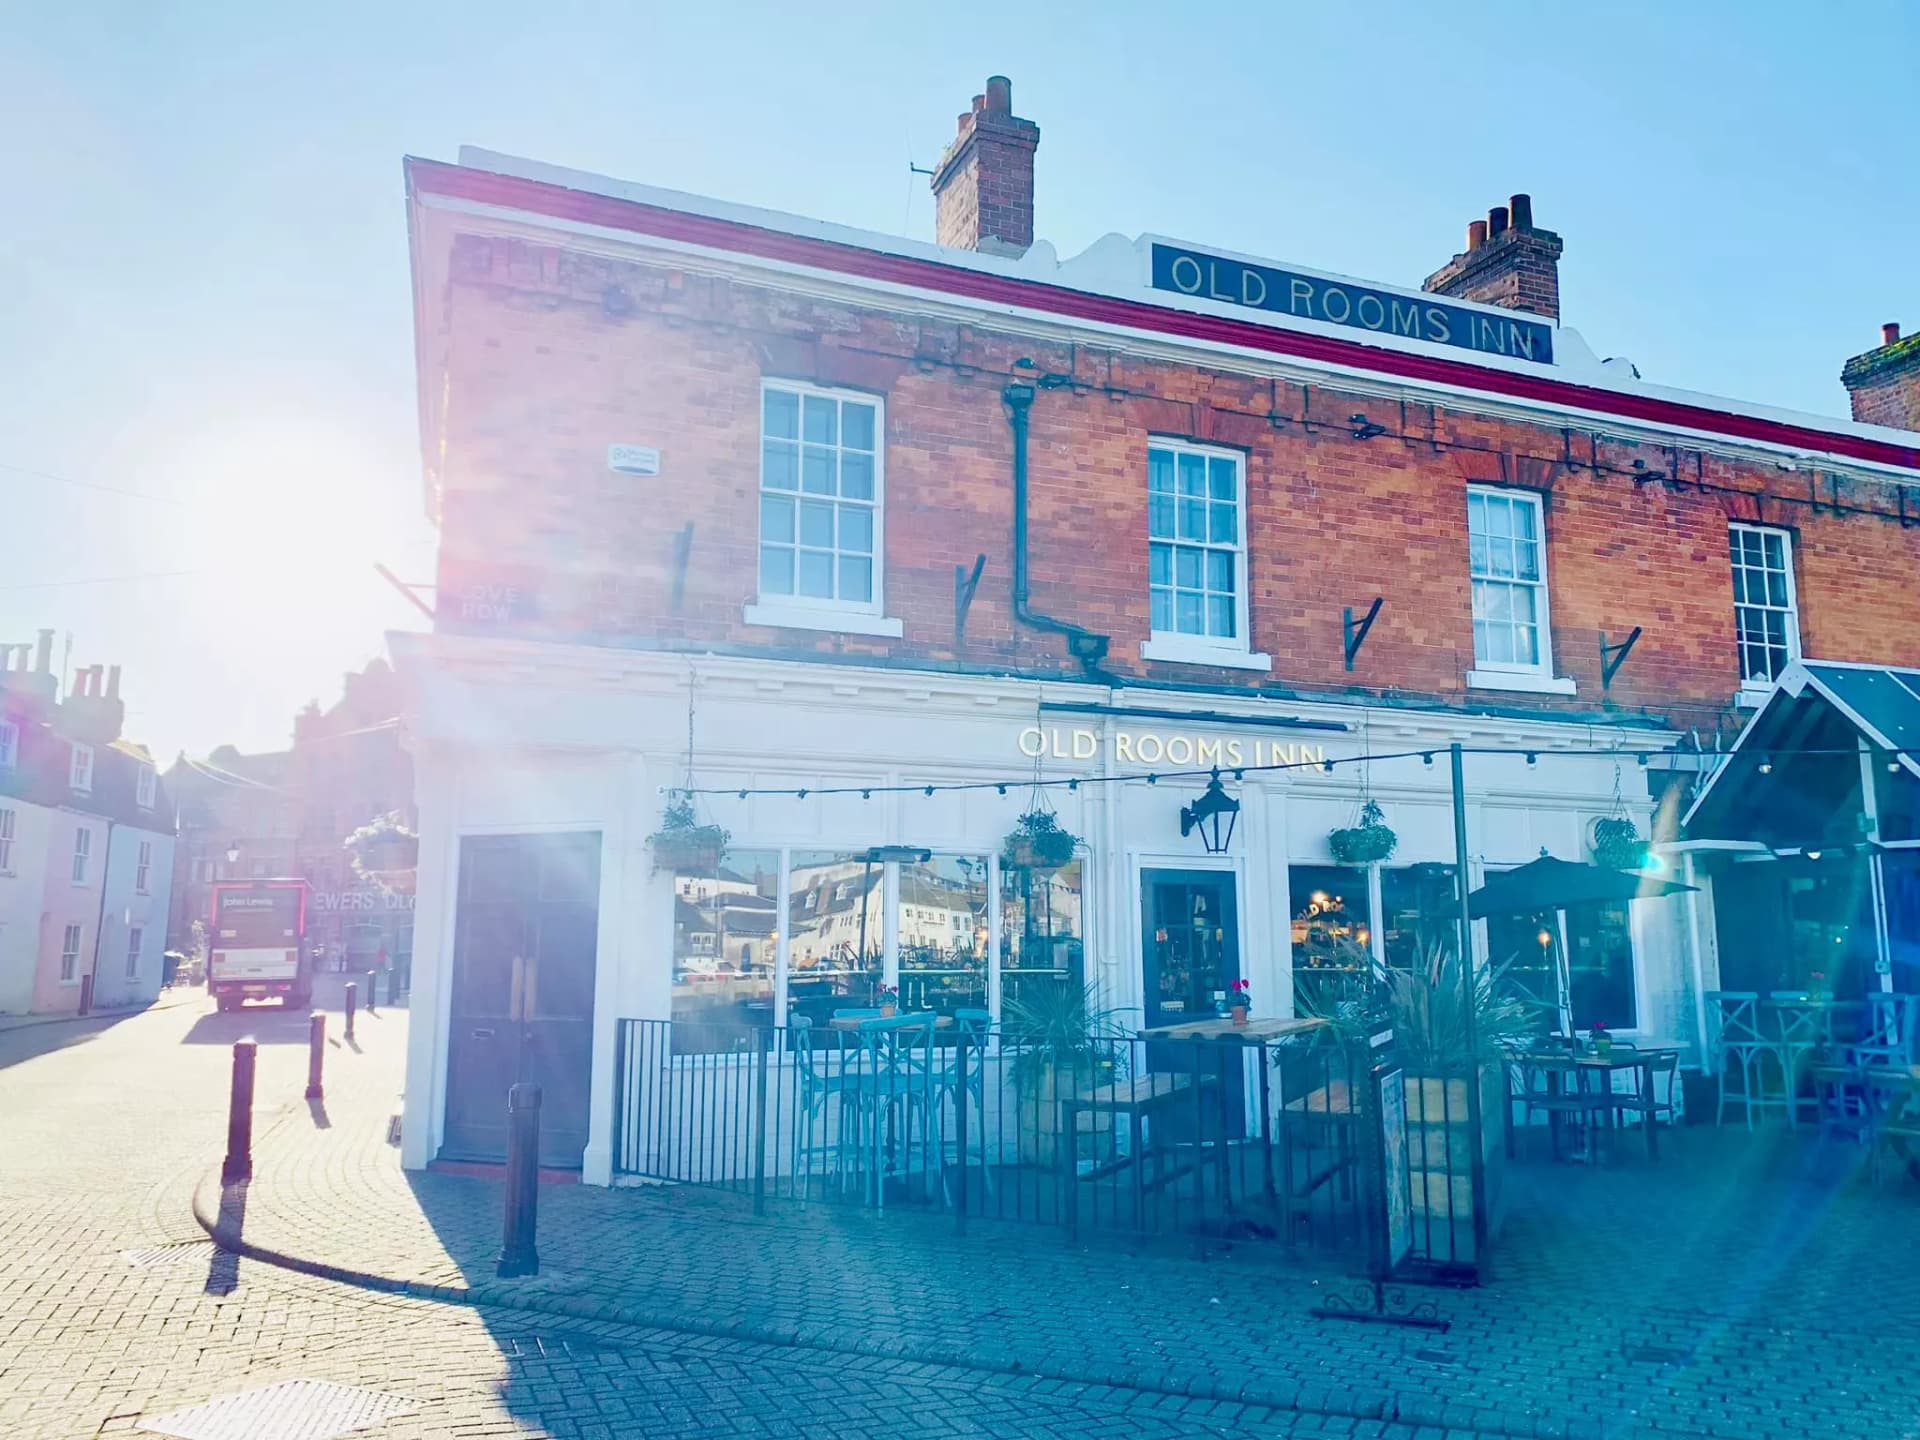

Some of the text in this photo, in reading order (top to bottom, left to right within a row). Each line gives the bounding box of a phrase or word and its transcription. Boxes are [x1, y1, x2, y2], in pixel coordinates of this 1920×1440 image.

[1171, 255, 1533, 360] OLD ROOMS INN
[1017, 728, 1326, 773] OLD ROOMS INN
[313, 892, 375, 910] EWERS
